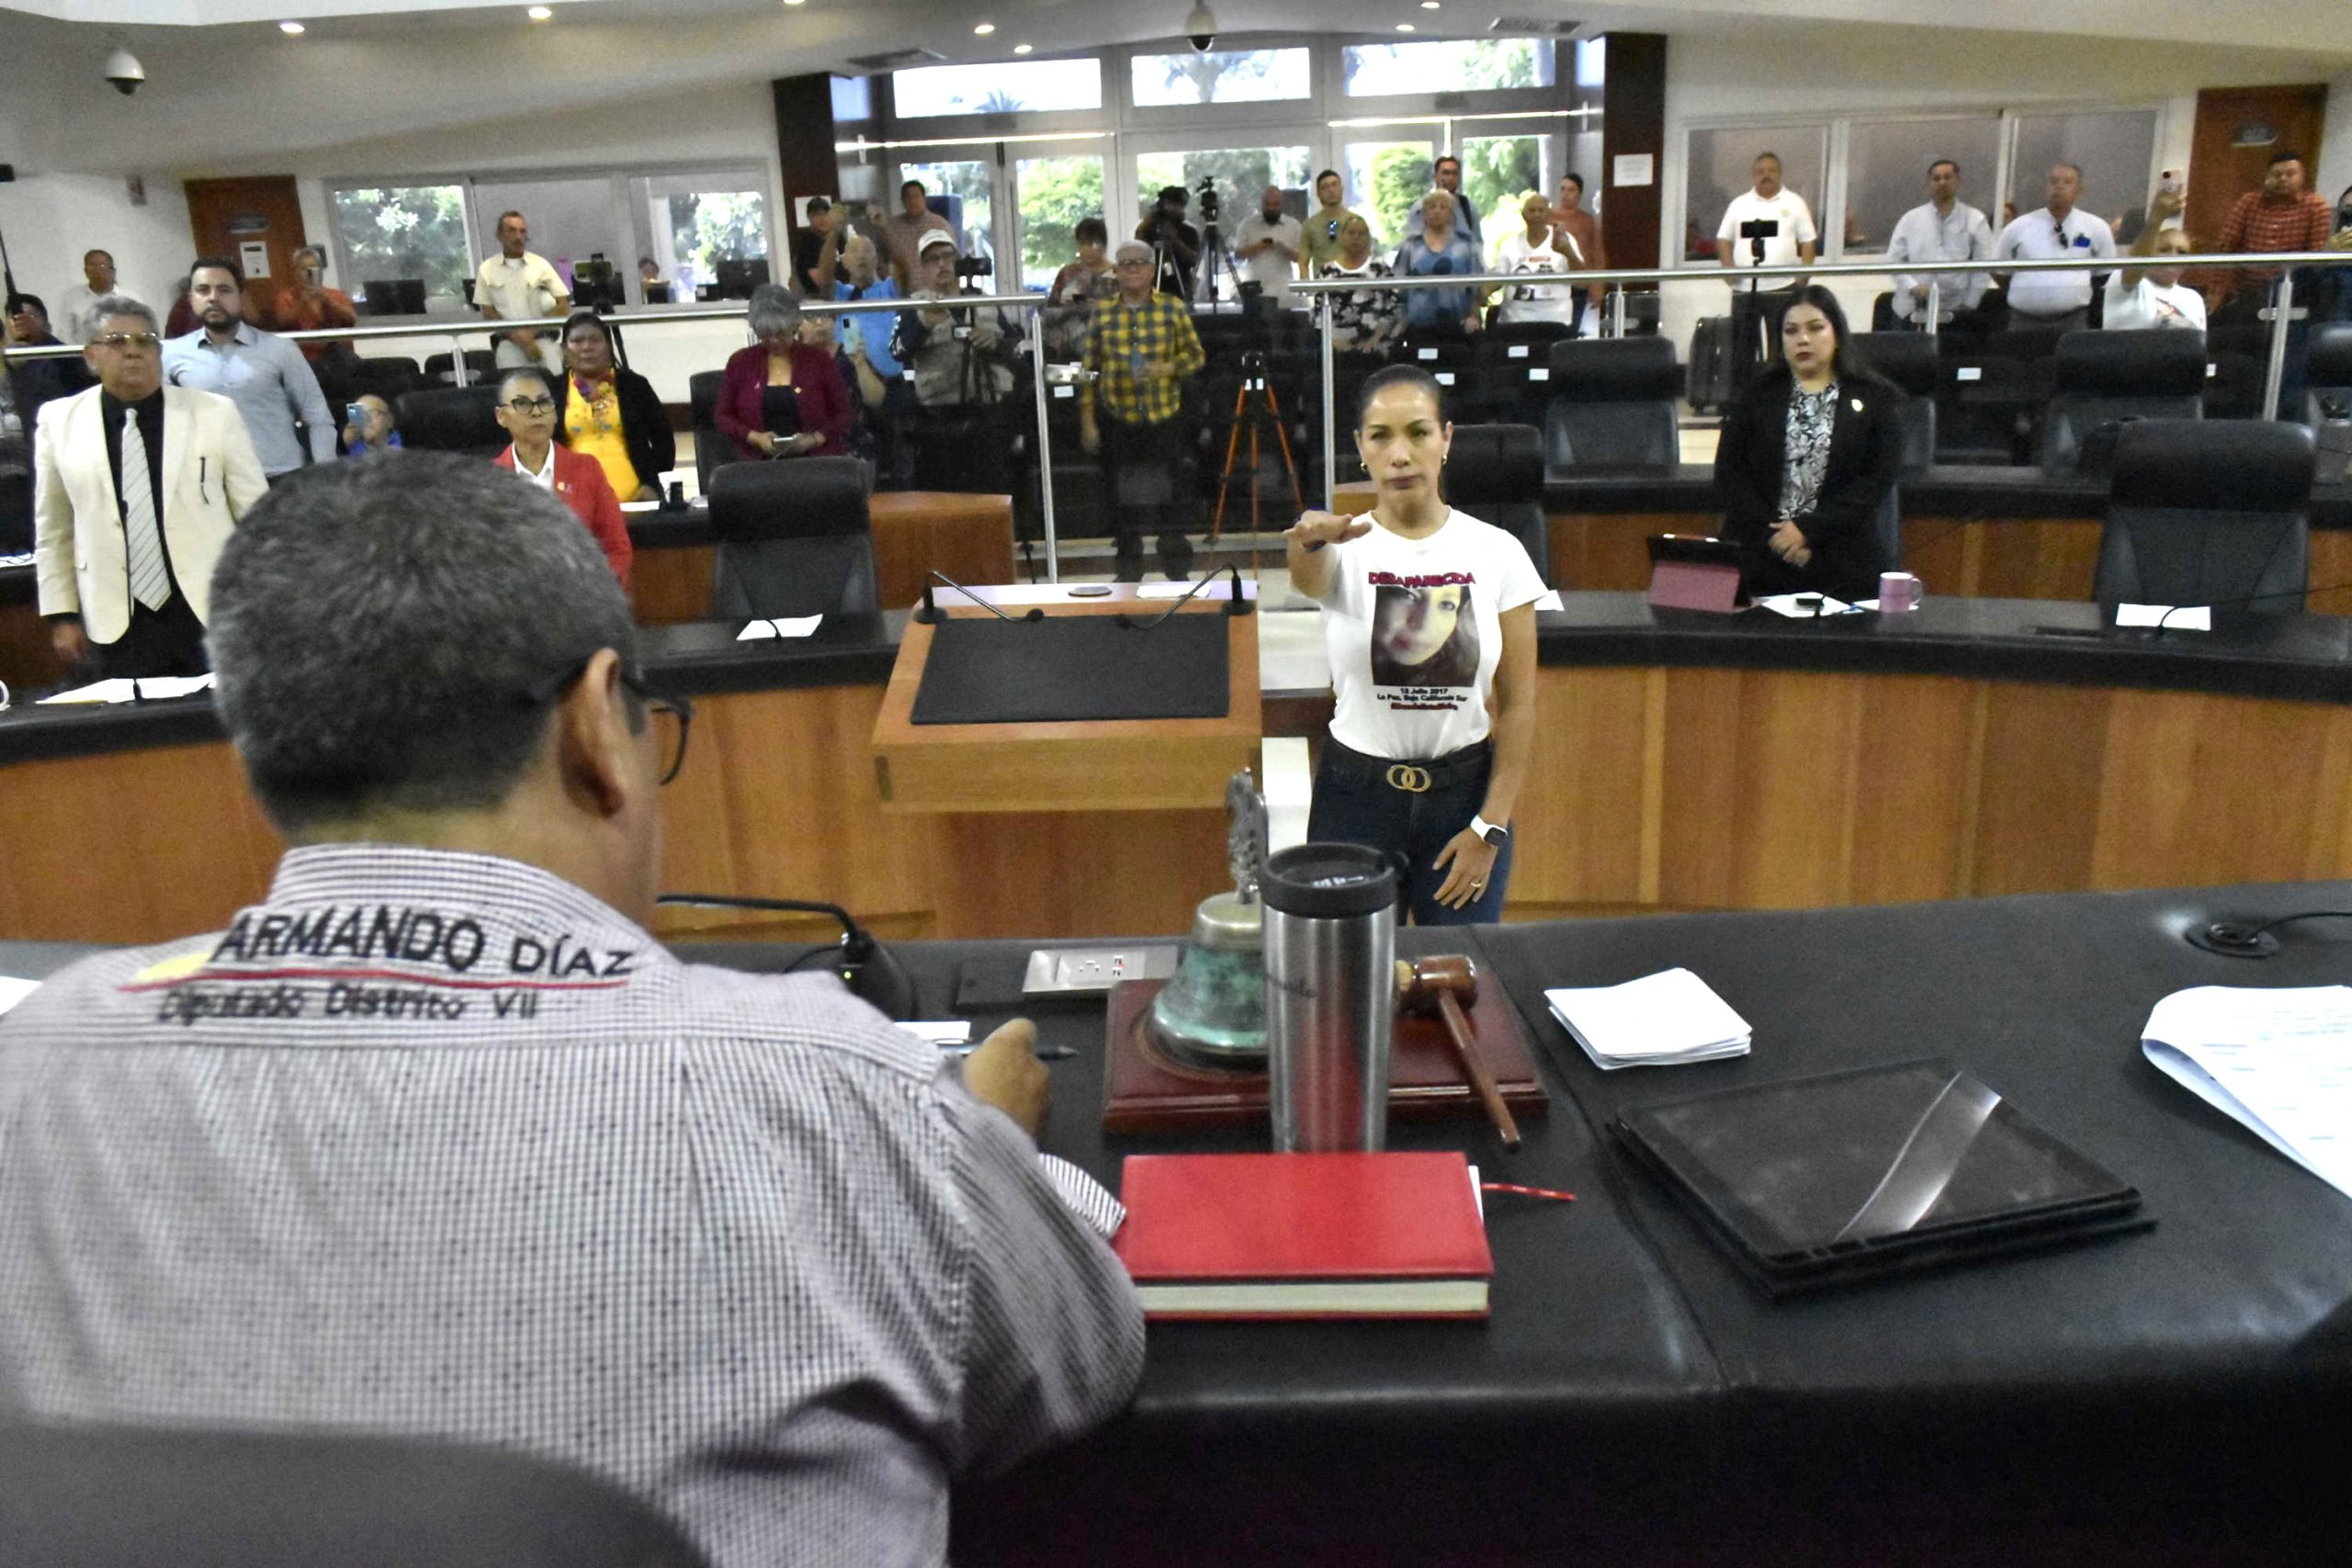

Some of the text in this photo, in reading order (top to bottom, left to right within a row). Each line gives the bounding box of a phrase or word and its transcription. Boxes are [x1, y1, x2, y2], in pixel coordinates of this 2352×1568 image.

[210, 905, 634, 976] ARMANDO DÍAZ
[325, 984, 467, 1020] Distrito
[492, 987, 537, 1019] VII
